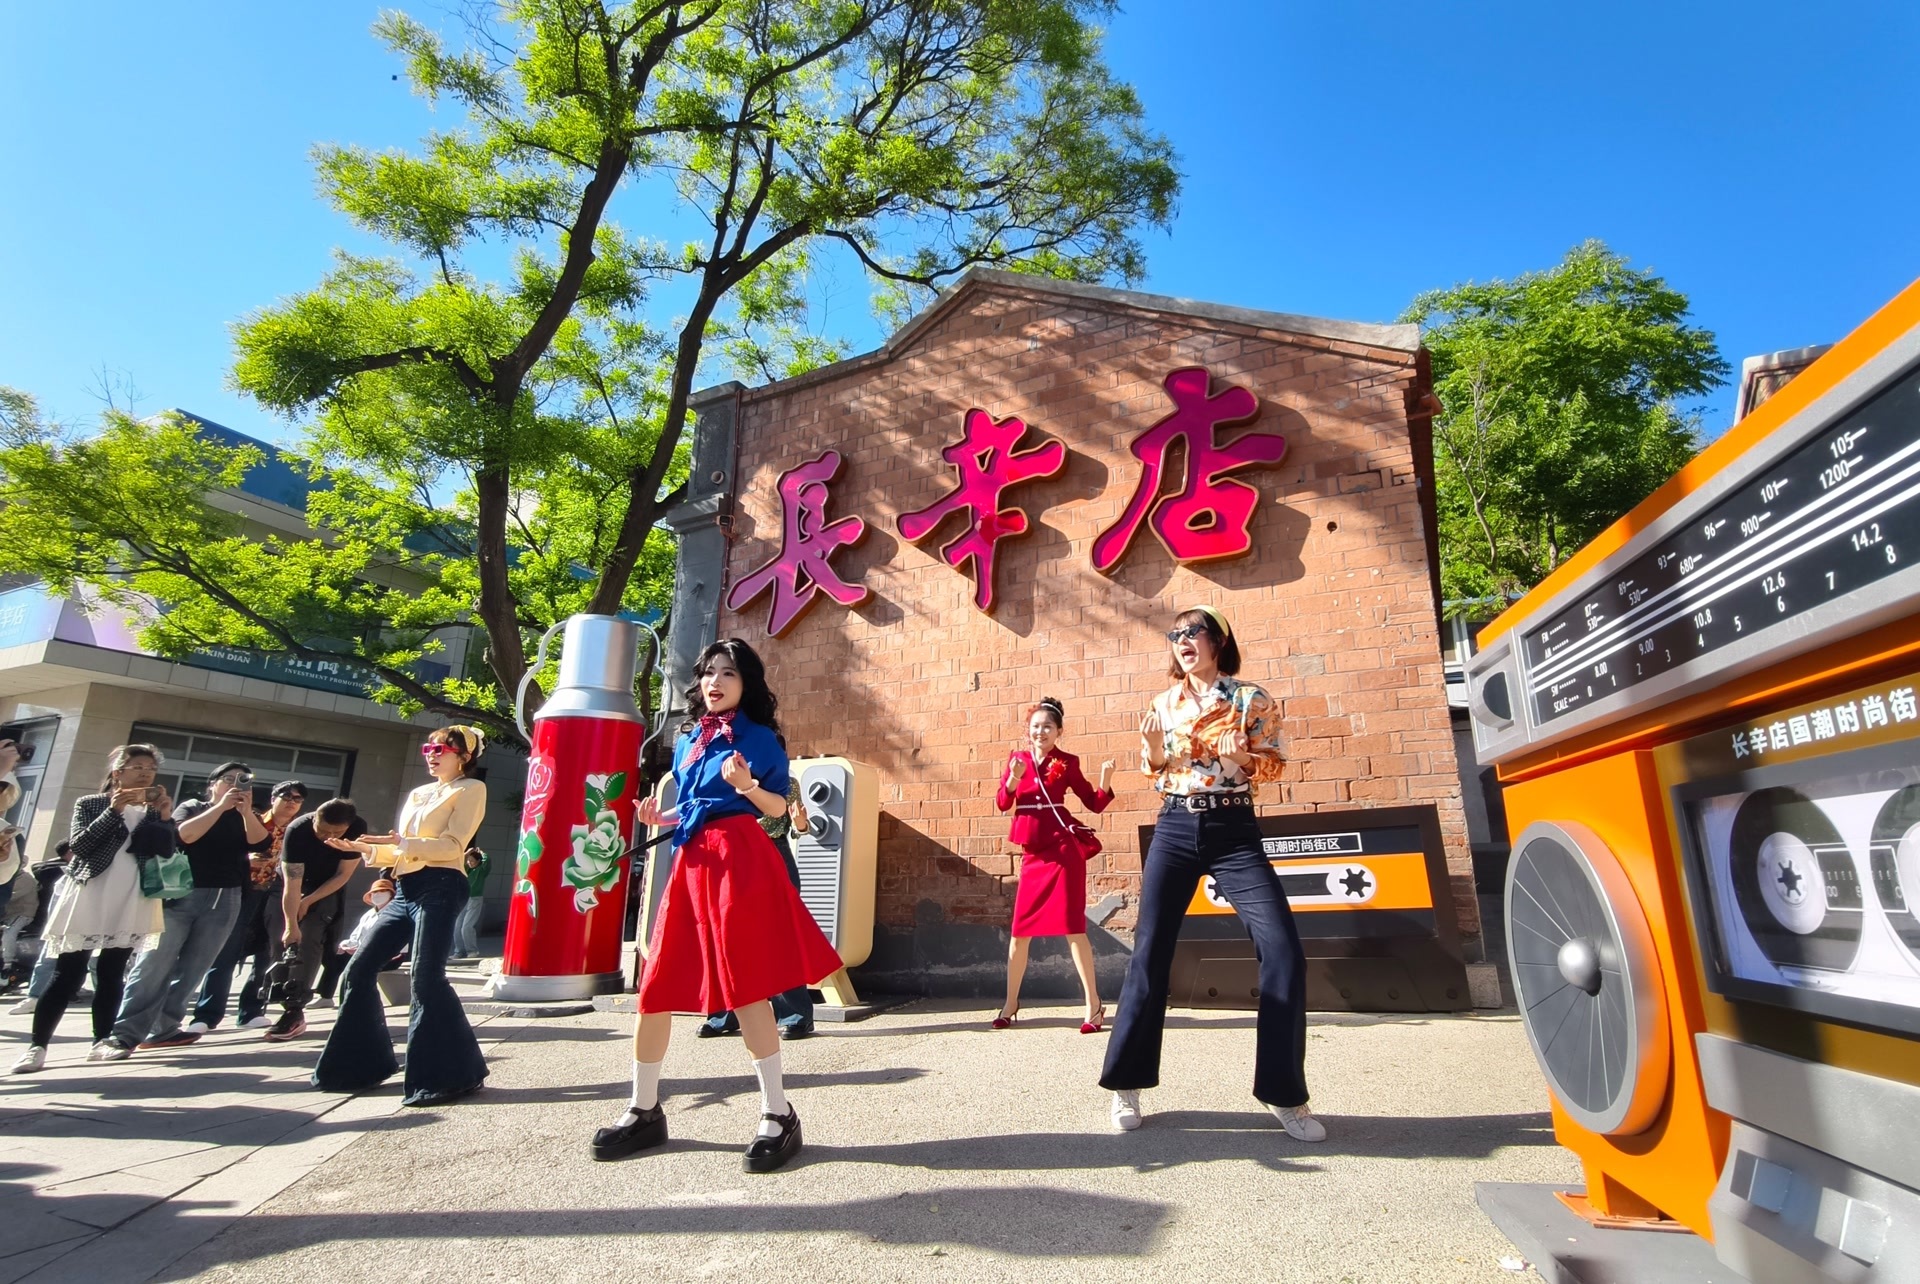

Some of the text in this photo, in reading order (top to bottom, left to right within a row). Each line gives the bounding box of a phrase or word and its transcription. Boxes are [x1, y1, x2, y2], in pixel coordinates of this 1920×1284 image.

[1541, 631, 1549, 644] FM
[1618, 581, 1627, 596] 89
[1657, 555, 1668, 570] 93
[1704, 522, 1716, 540] 96
[1760, 480, 1780, 503] 101
[1830, 431, 1855, 459] 105
[1587, 616, 1598, 631] 530
[1628, 589, 1641, 606] 530
[1680, 556, 1694, 575] 680
[1740, 515, 1759, 538] 900
[1819, 459, 1850, 489] 1200
[1553, 697, 1570, 713] SCALE
[1587, 685, 1593, 698] 0
[1636, 663, 1642, 676] 2
[1665, 649, 1671, 663] 3
[1698, 633, 1705, 648] 4
[1734, 615, 1742, 632] 5
[1777, 595, 1786, 613] 6
[1825, 571, 1835, 591] 7
[1885, 544, 1897, 564] 8
[1594, 661, 1608, 678] 8.00
[1638, 638, 1654, 656] 9.00
[1694, 608, 1712, 629] 10.8
[1762, 571, 1786, 595] 12.6
[1851, 523, 1884, 552] 14.2
[226, 653, 251, 664] DIAN
[284, 667, 328, 681] INVESTMENT
[1732, 687, 1918, 759] 长辛店国潮时尚街
[1262, 837, 1341, 854] 国潮时尚街区
